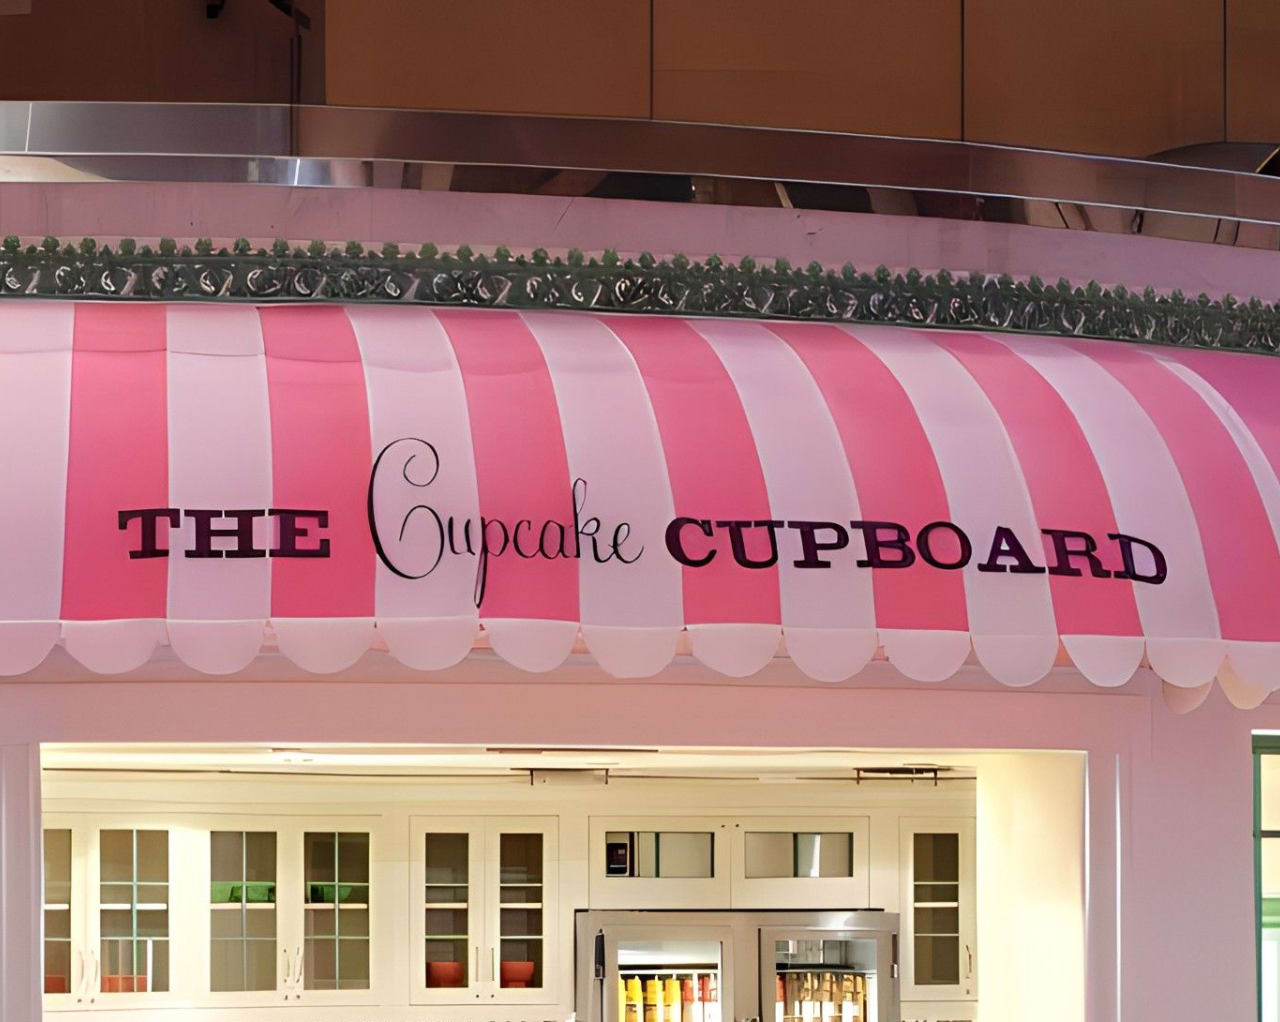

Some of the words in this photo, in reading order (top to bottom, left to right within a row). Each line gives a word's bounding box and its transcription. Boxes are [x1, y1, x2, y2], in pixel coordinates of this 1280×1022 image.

[118, 508, 330, 560] THE
[366, 437, 644, 610] Cupcake
[665, 516, 1168, 585] CUPBOARD
